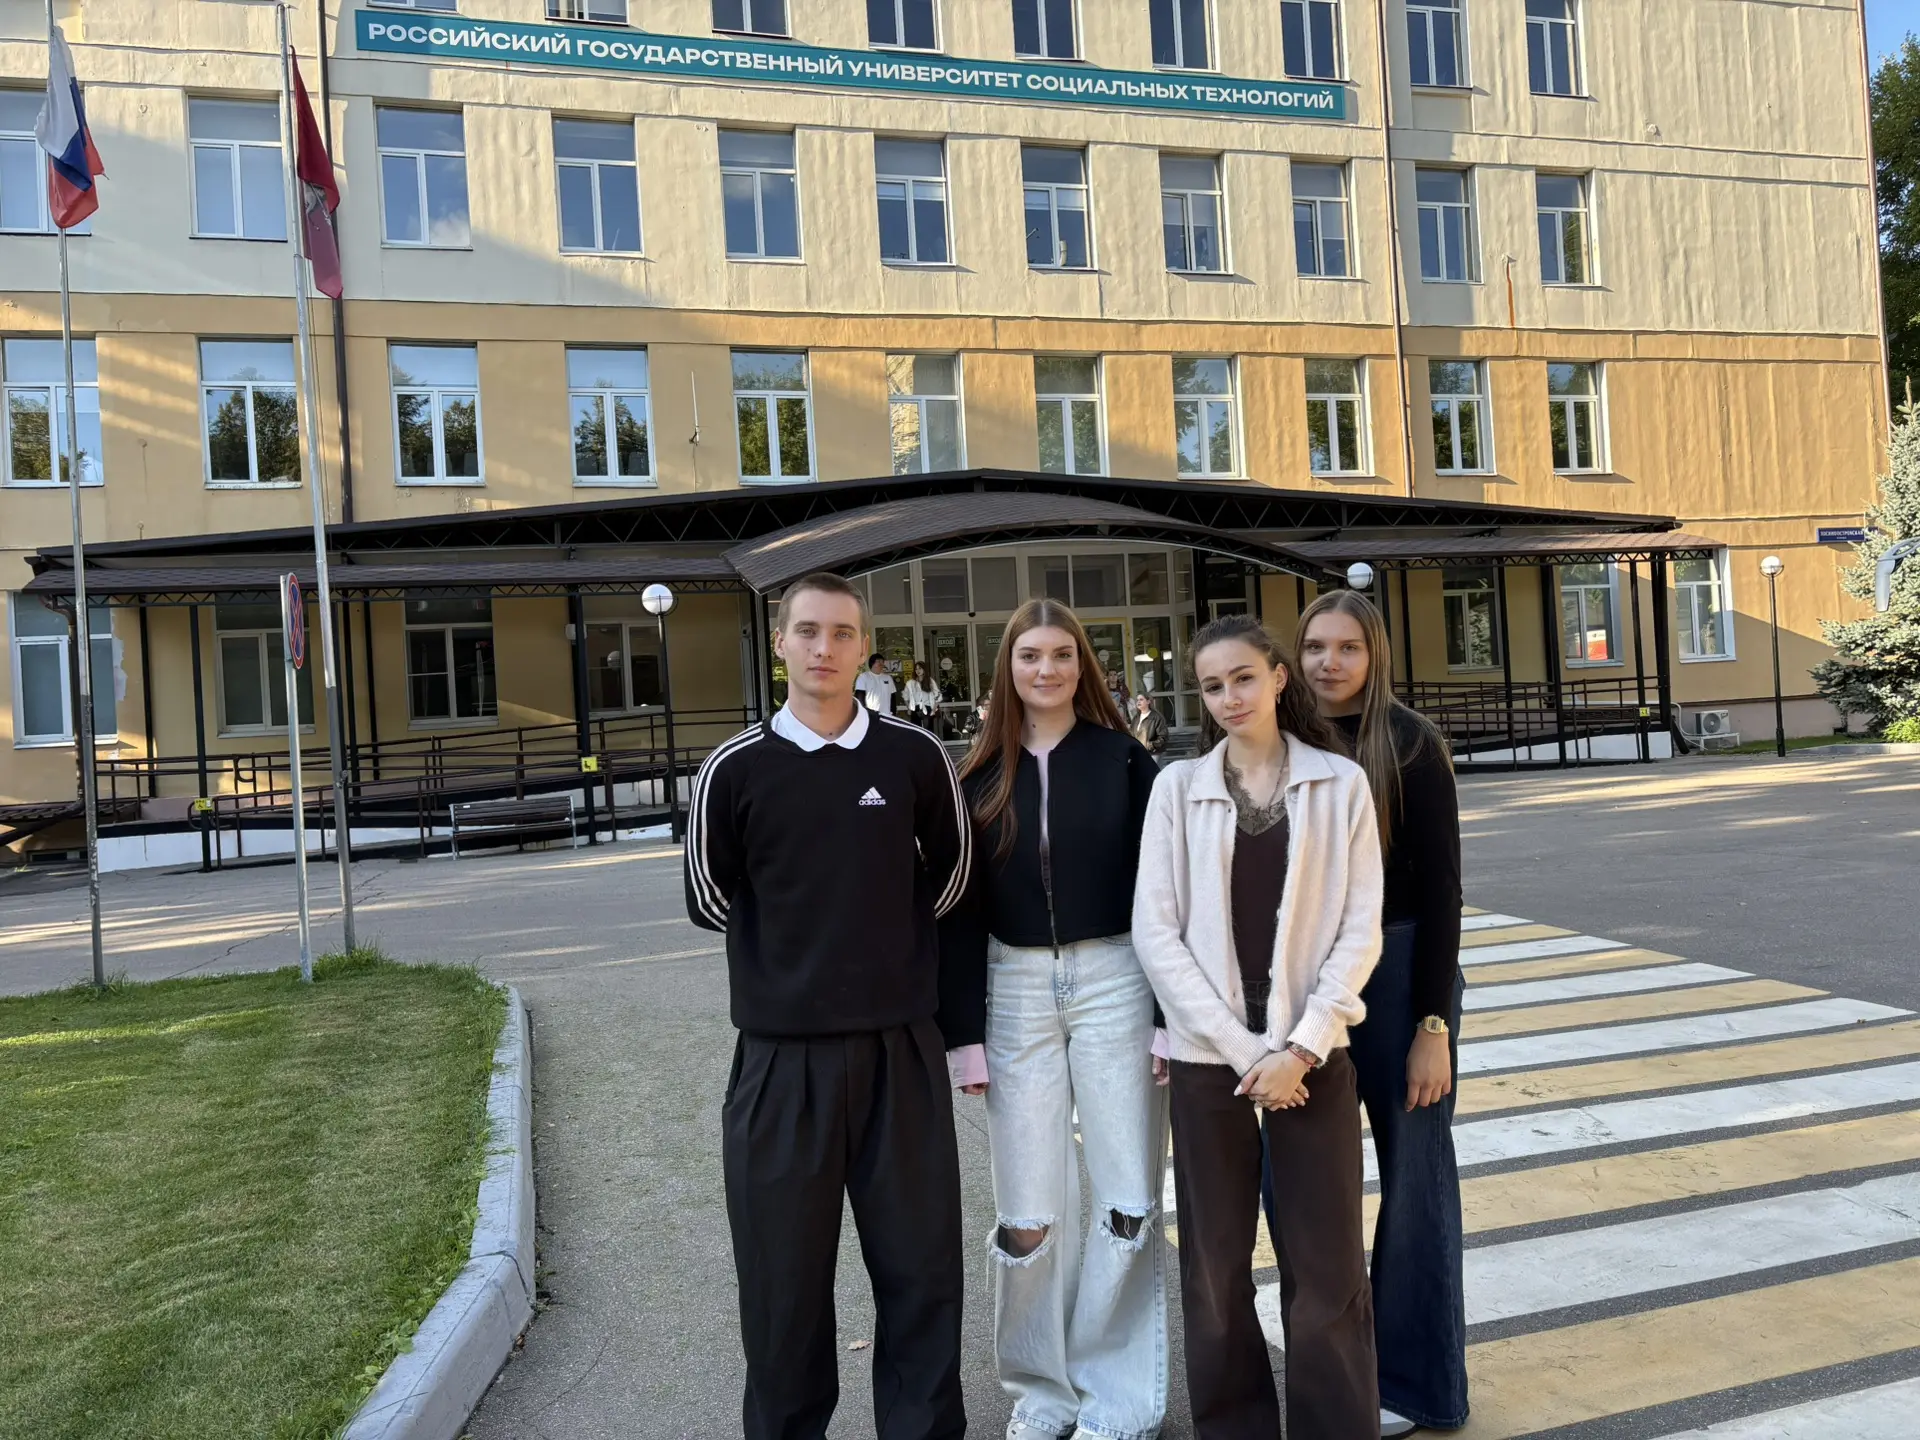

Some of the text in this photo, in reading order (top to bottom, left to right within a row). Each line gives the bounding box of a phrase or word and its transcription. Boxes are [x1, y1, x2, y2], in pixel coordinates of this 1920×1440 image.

[368, 23, 1334, 109] РОССИЙСКИЙ ГОСУДАРСТВЕННЫЙ УНИВЕРСИТЕТ СОЦИАЛЬНЫХ ТЕХНОЛОГИЙ
[858, 798, 886, 806] adidas
